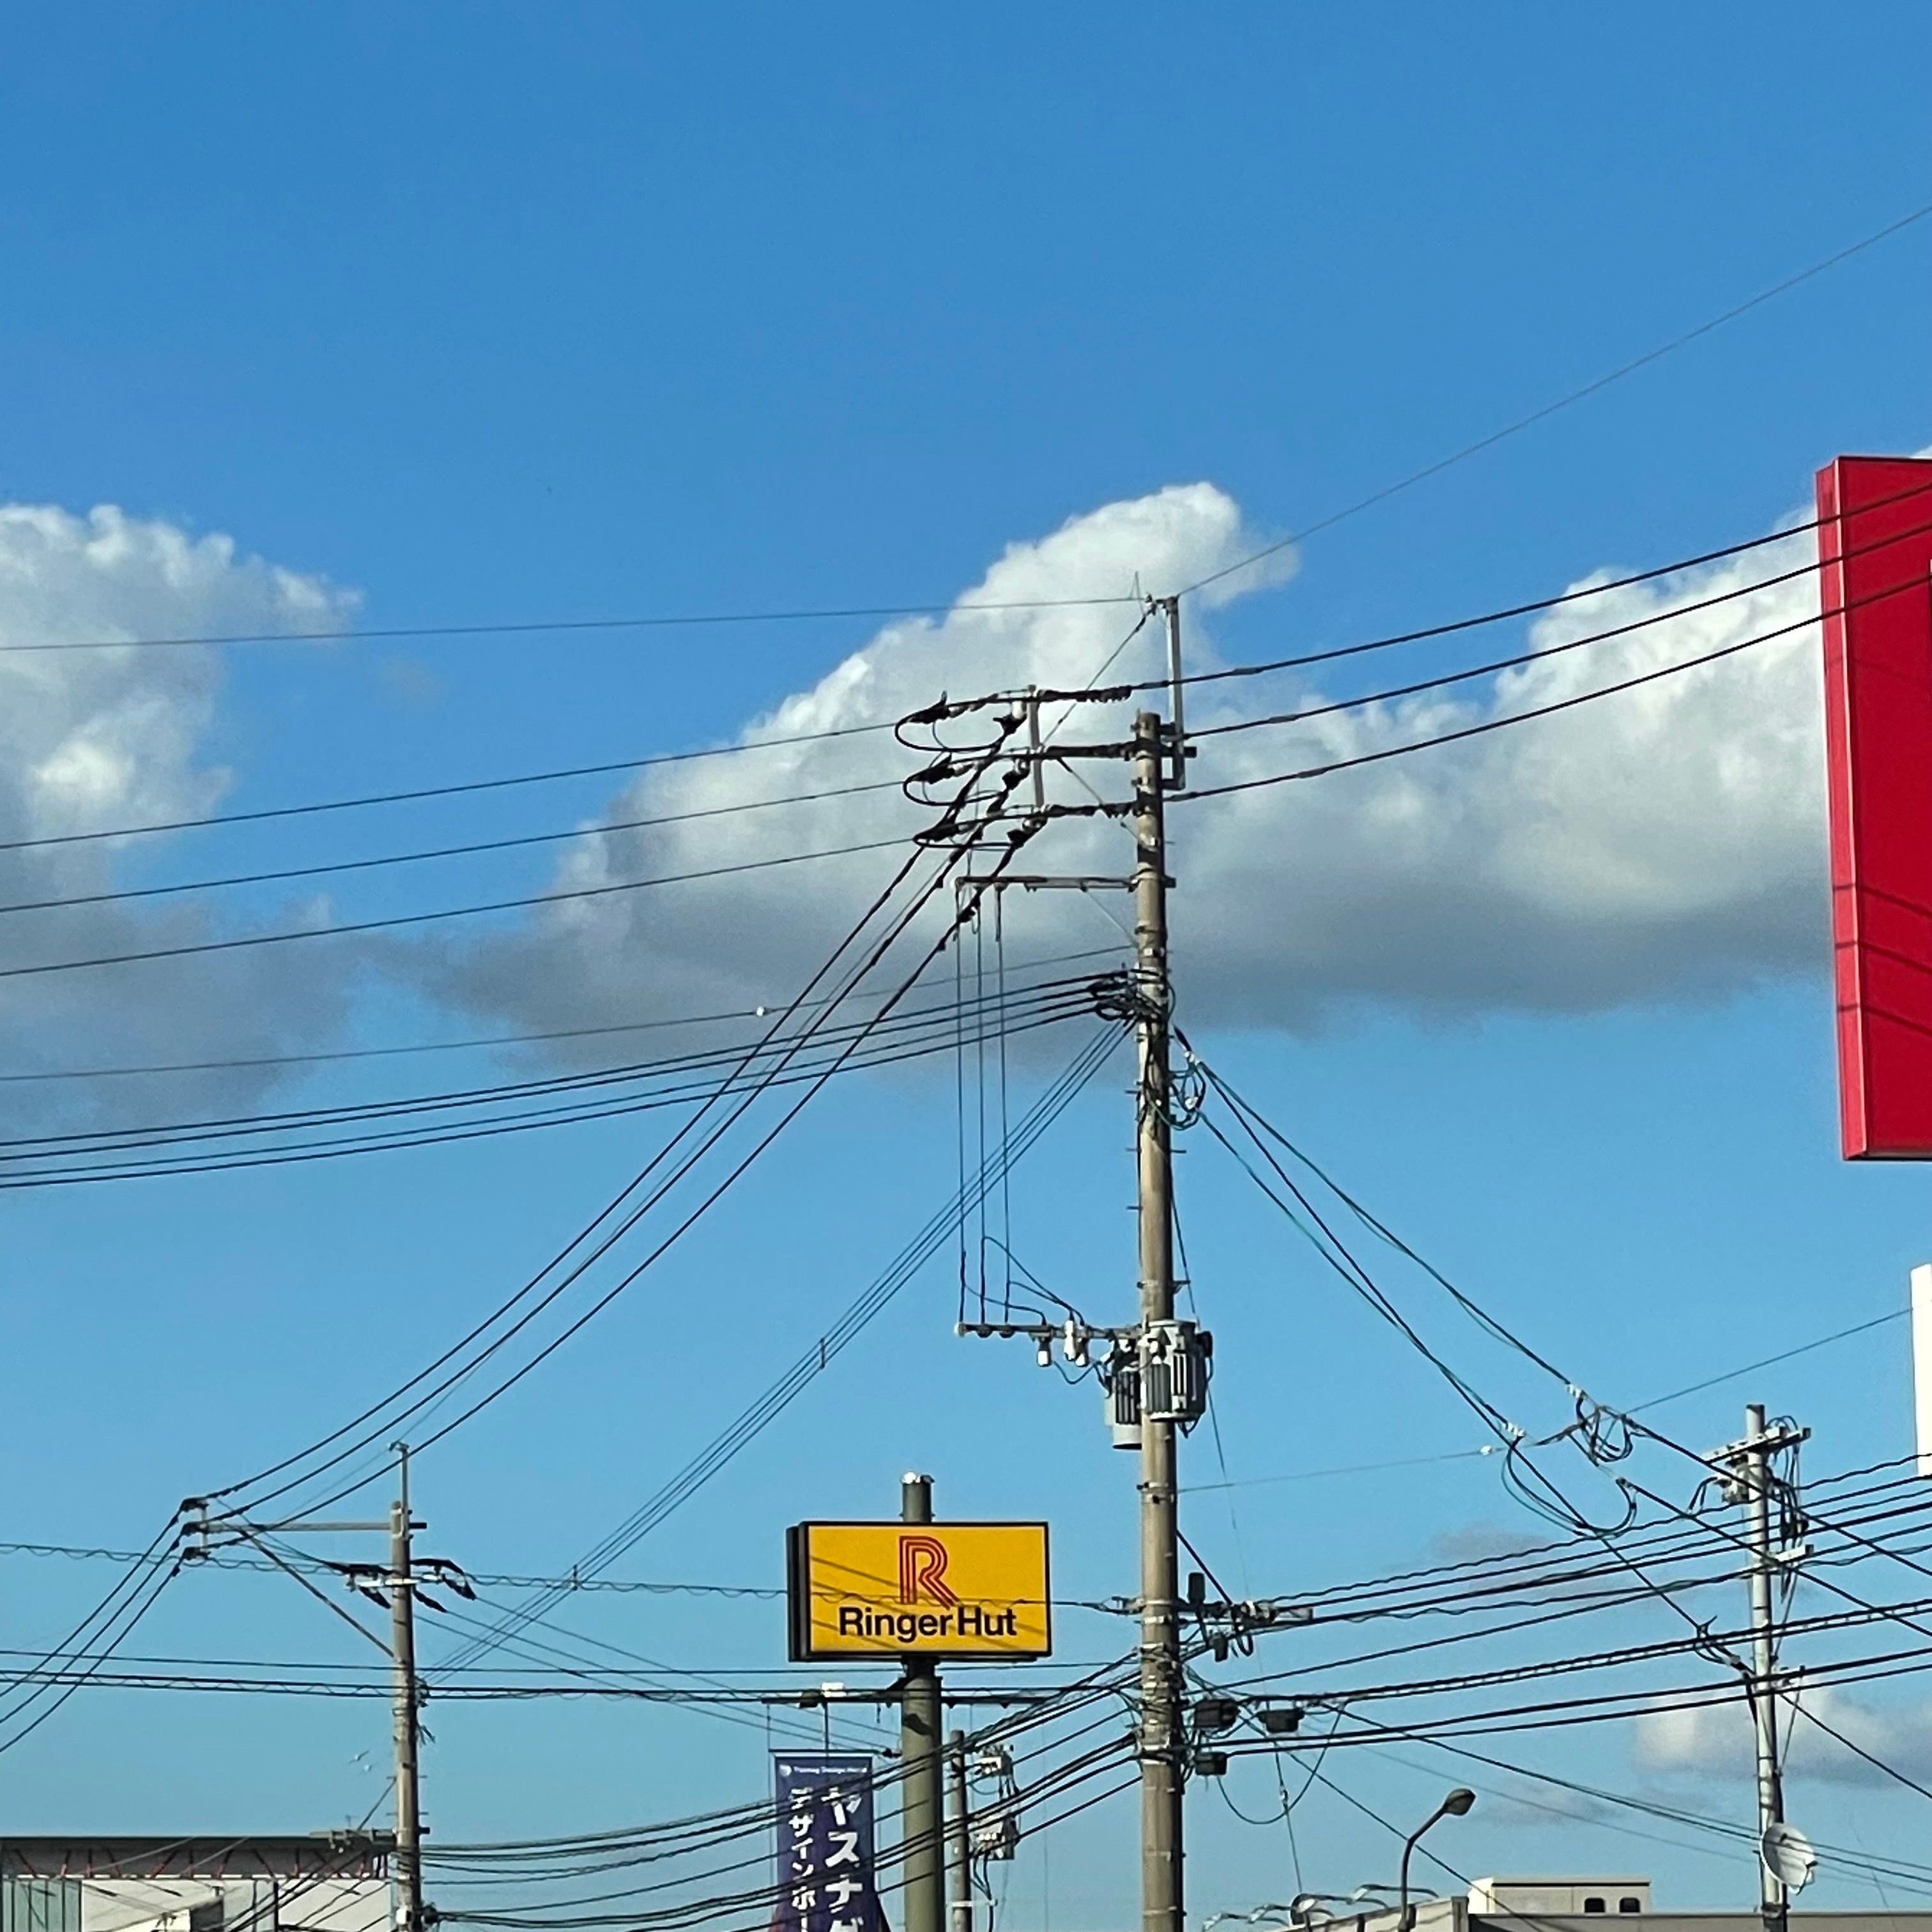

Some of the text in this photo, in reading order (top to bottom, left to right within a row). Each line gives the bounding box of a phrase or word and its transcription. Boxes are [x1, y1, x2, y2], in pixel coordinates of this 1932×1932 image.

[899, 1535, 959, 1610] R
[839, 1606, 1017, 1643] Ringer Hut
